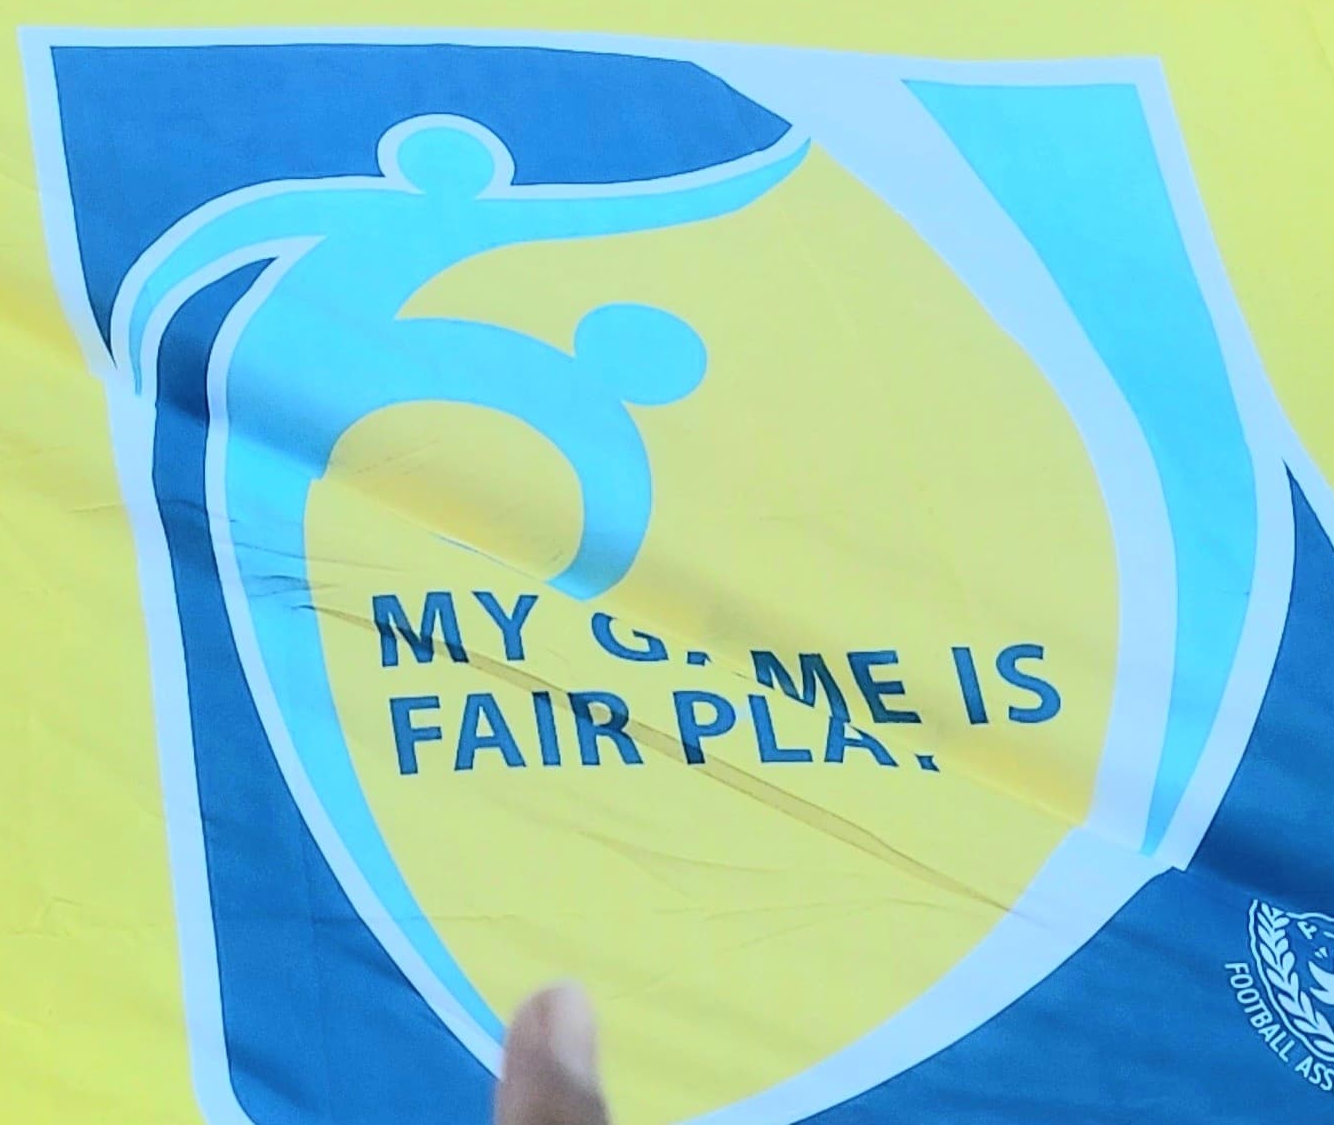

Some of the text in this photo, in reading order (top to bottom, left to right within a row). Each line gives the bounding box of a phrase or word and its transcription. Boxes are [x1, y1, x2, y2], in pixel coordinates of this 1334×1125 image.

[372, 590, 1063, 726] MY GME IS
[388, 691, 940, 776] FAIR PLA
[1225, 962, 1296, 1063] FOOTBALL
